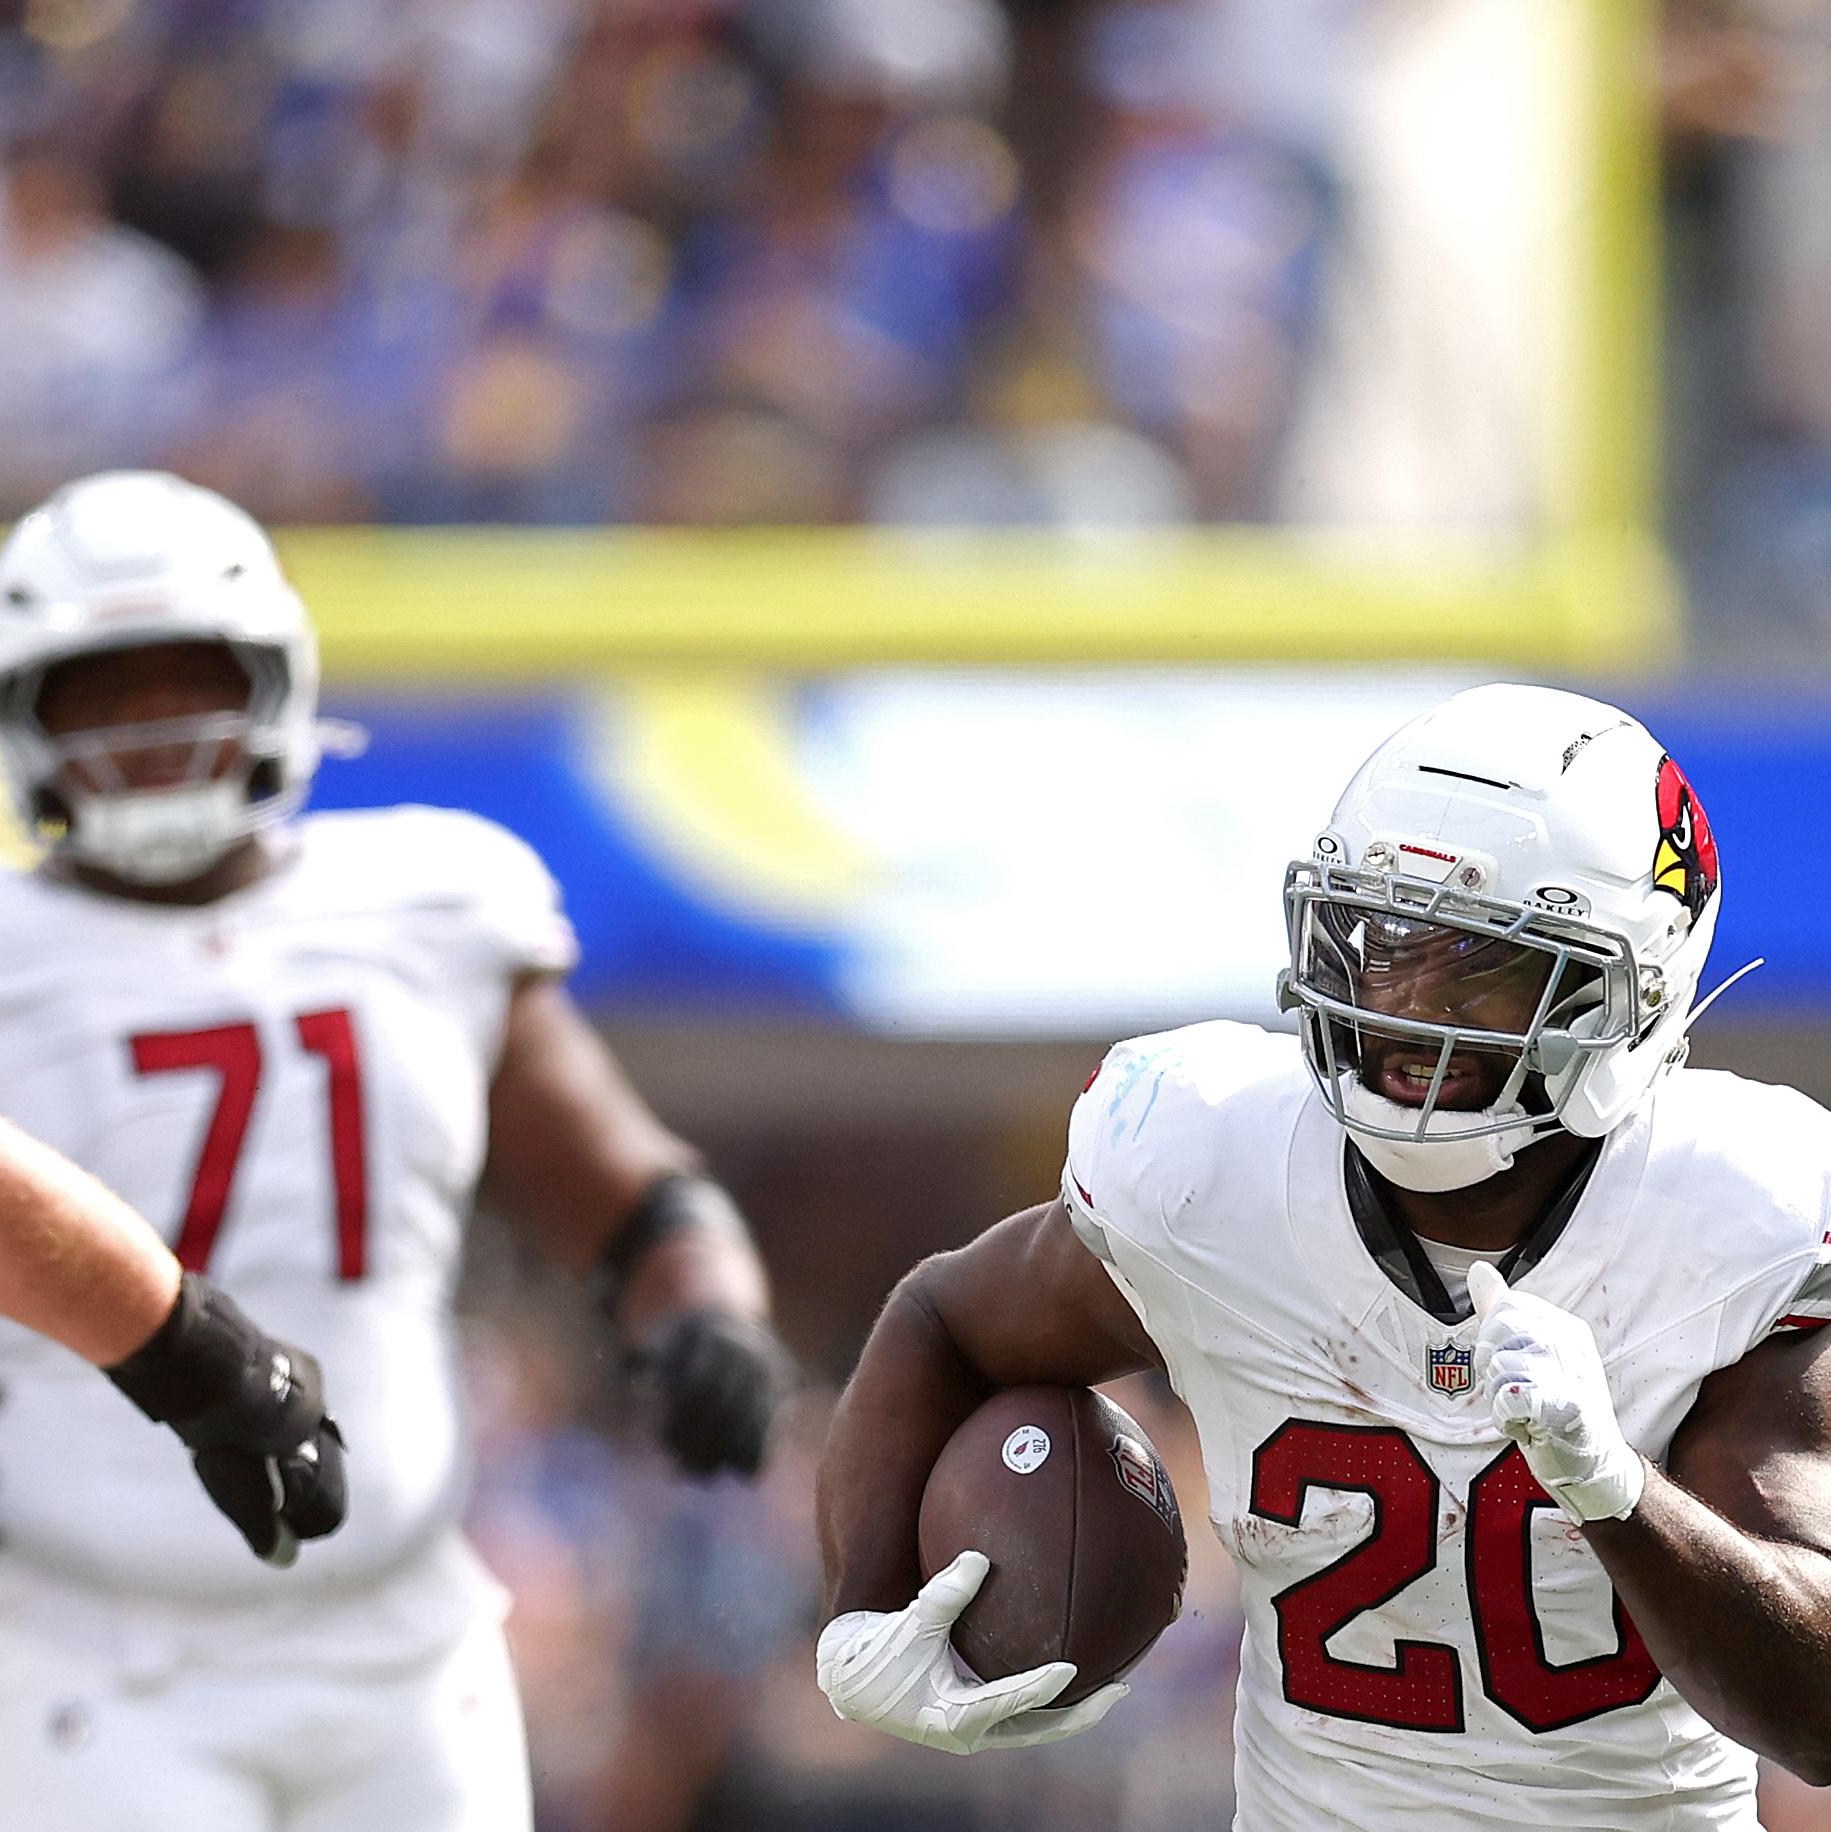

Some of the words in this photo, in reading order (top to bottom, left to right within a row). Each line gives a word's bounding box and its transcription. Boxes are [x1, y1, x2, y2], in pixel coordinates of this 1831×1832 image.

[1399, 844, 1457, 863] CARDINALS
[1522, 900, 1585, 916] OAKLEY
[130, 1008, 370, 1283] 71
[1433, 1365, 1468, 1390] NFL
[1248, 1417, 1664, 1734] 20
